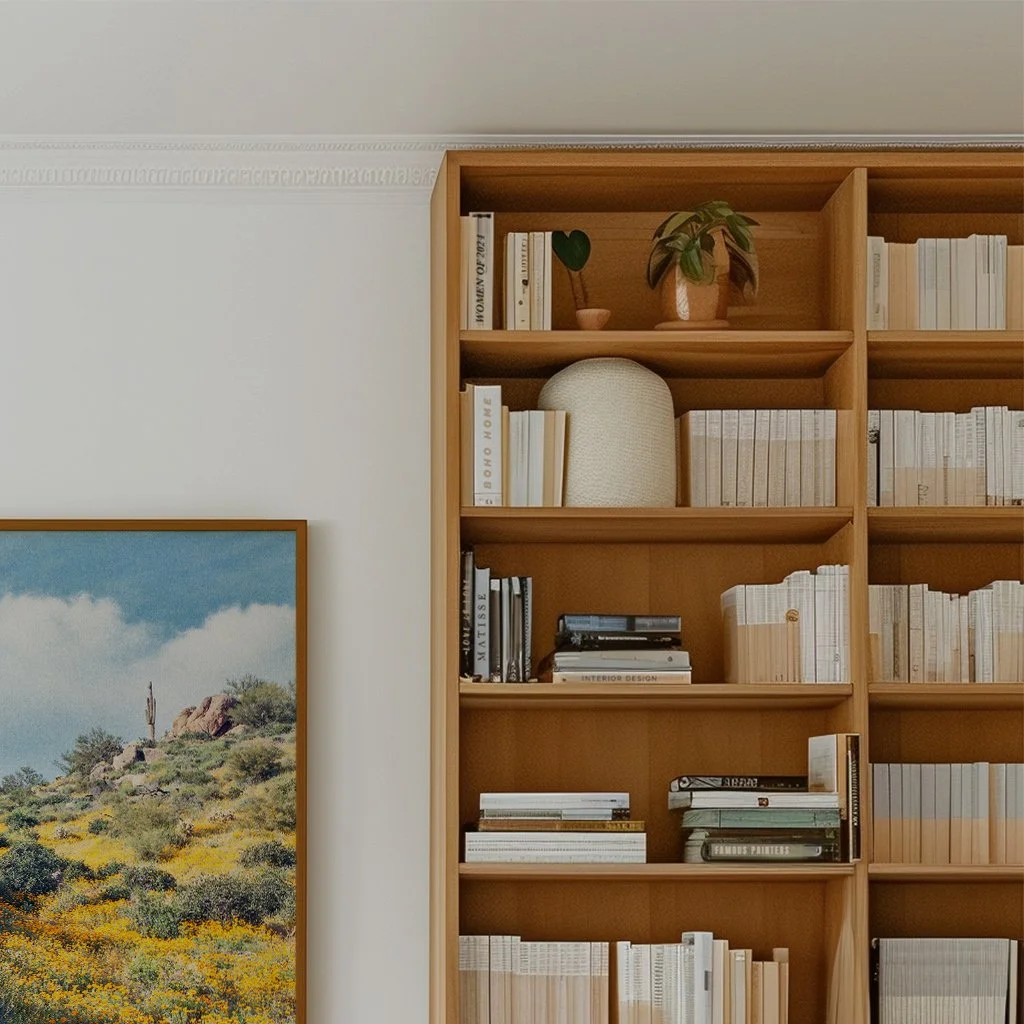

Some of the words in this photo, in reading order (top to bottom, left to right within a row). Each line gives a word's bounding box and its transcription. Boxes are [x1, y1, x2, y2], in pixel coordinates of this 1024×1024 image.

[477, 234, 485, 258] 2024
[476, 259, 485, 276] OF
[475, 278, 484, 323] WOMEN
[483, 398, 492, 440] HOME
[483, 447, 492, 489] BOHO
[477, 593, 487, 661] MATISSE
[714, 845, 747, 855] FAMOUS
[750, 845, 790, 855] PAINTERS
